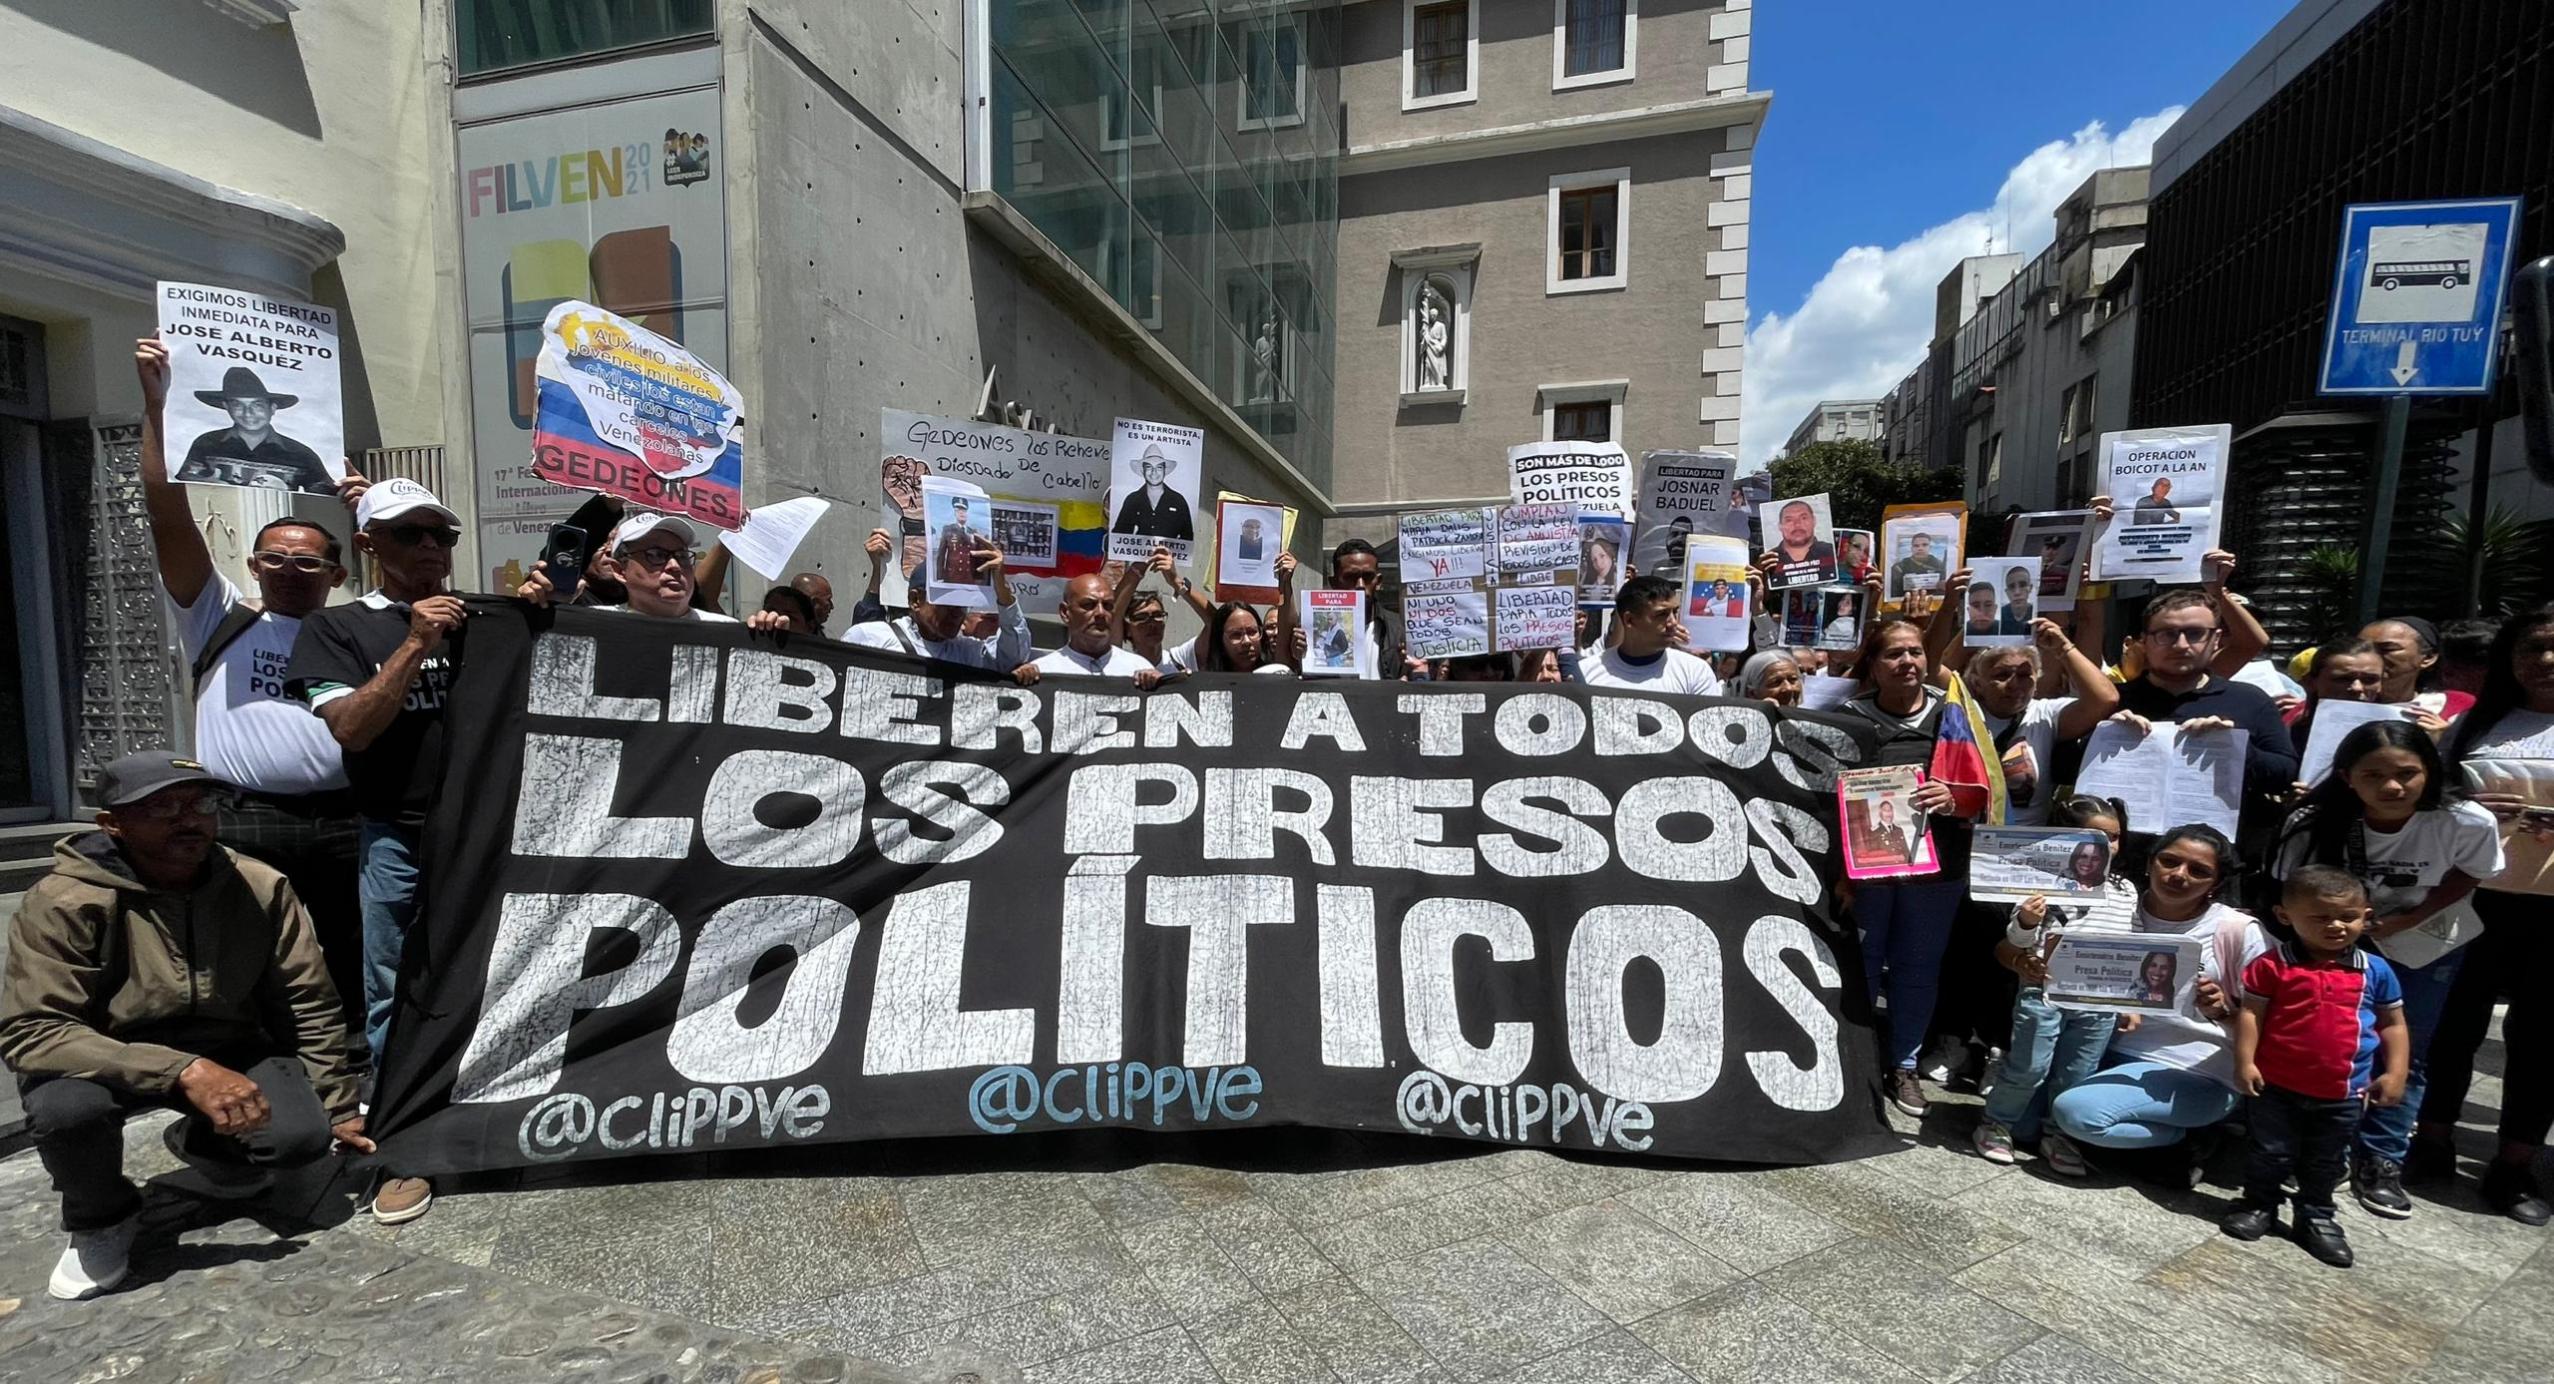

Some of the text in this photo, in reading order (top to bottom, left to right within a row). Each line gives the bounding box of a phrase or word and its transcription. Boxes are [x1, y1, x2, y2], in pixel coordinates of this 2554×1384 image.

[468, 142, 651, 218] FILVEN 20
[626, 168, 650, 195] 21
[167, 287, 332, 325] EXIGIMOS LIBERTAD
[181, 306, 320, 340] INMEDIATA PARA
[2342, 327, 2484, 345] TERMINAL RIO TUY
[230, 331, 332, 360] ALBERTO
[196, 343, 303, 371] VASQUÉZ
[585, 362, 642, 393] civiles
[647, 366, 717, 401] militares
[588, 382, 666, 418] matando
[619, 409, 689, 443] carceles
[1117, 421, 1130, 429] NO
[599, 419, 704, 464] Venezolanas
[1141, 433, 1154, 441] UN
[1156, 436, 1191, 447] ARTISTA
[1517, 458, 1544, 471] SON
[1546, 455, 1573, 467] MÁS
[1575, 456, 1592, 466] DE
[2128, 450, 2196, 463] OPERACION
[1018, 458, 1040, 473] De
[1660, 466, 1722, 478] LIBERTAD PARA
[2115, 462, 2208, 476] BOICOT A LA AN
[1042, 472, 1101, 490] Cabello
[1520, 471, 1620, 488] LOS PRESOS
[1657, 480, 1720, 496] JOSNAR
[496, 485, 579, 499] Internaciona
[1523, 484, 1621, 504] POLÍTICOS
[1501, 503, 1568, 520] CUMPLAN
[1655, 496, 1717, 512] BADUEL
[512, 521, 552, 534] Venez
[1553, 513, 1575, 529] LEY
[1112, 547, 1154, 557] VASQUE
[1560, 541, 1574, 552] DE
[1429, 557, 1450, 578] YA
[1409, 580, 1472, 595] VENEZUELA
[1498, 589, 1574, 609] LIBERTAD
[1427, 606, 1457, 618] DOS
[1497, 606, 1574, 621] PARA TODOS
[1406, 619, 1434, 630] QUE
[1524, 620, 1573, 634] PRESOS
[1413, 636, 1483, 660] JUSTICIA
[527, 633, 1863, 792] LIBEREN A TODOS
[511, 732, 1830, 906] LOS PRESOS
[450, 854, 1845, 1112] POLÍTICOS
